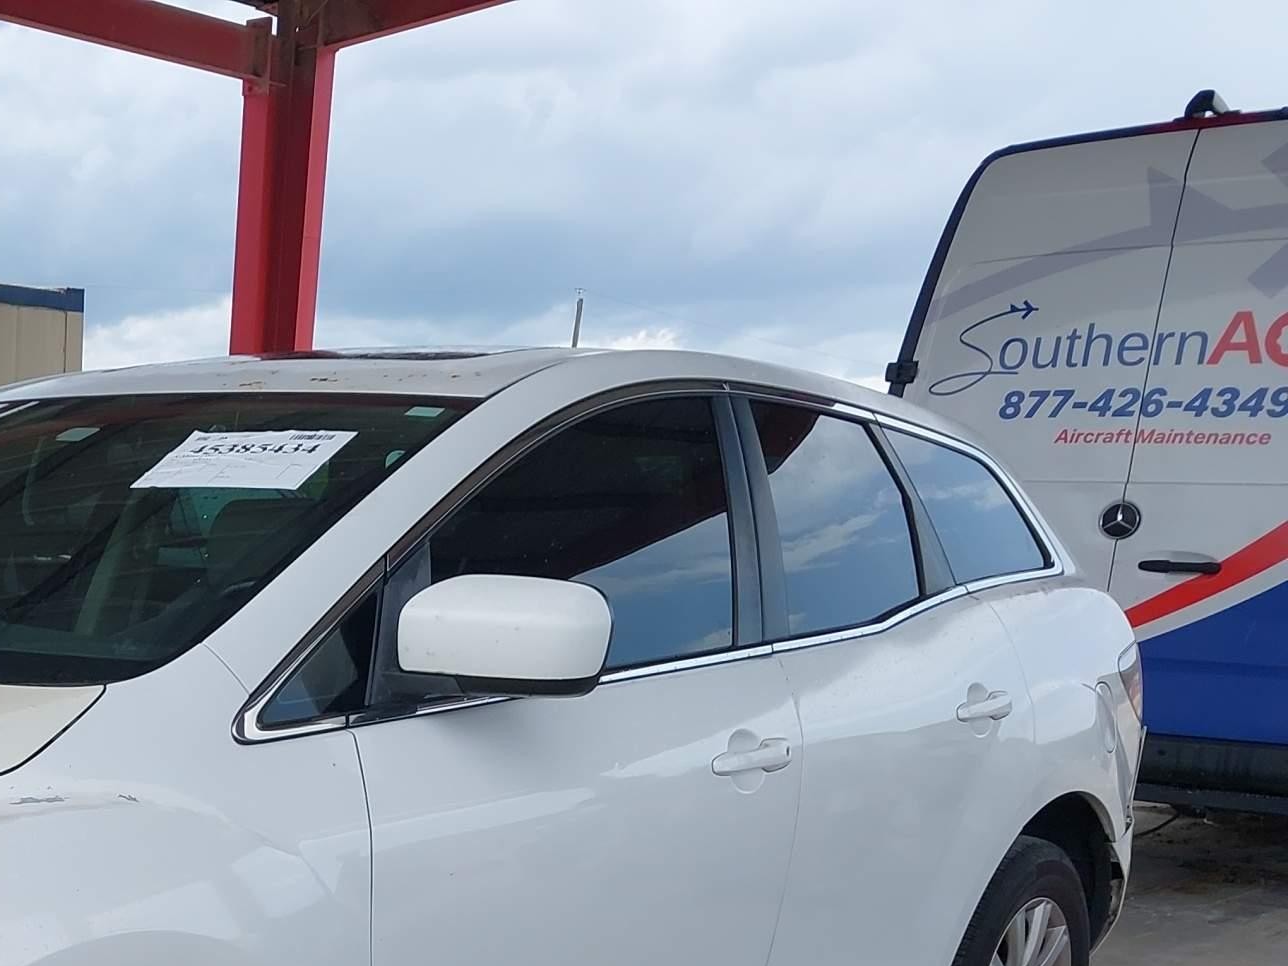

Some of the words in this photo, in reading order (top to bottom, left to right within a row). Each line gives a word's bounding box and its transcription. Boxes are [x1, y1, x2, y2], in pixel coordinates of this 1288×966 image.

[998, 387, 1288, 419] 877-426-4349
[1053, 428, 1132, 445] Aircraft
[1135, 428, 1272, 446] Maintenance
[189, 442, 321, 455] 45385434
